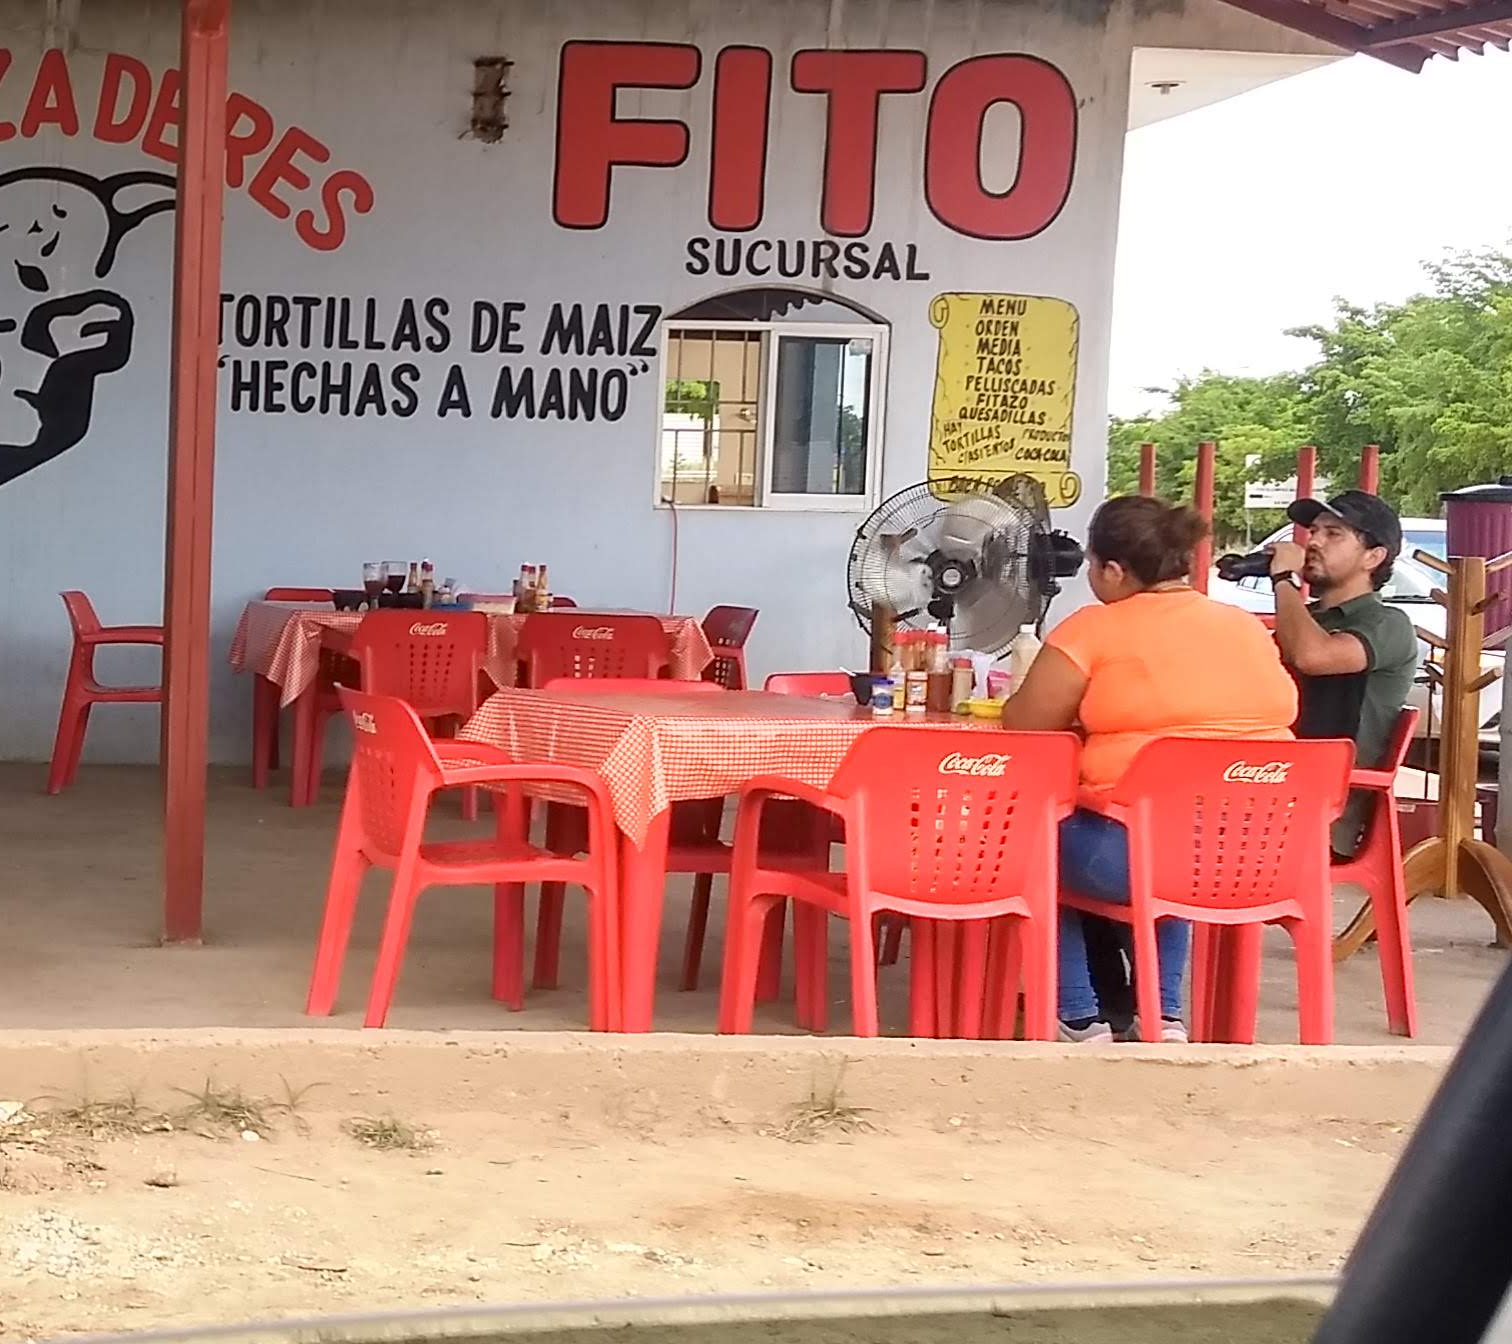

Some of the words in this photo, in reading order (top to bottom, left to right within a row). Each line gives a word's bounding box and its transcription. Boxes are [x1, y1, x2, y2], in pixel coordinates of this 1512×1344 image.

[552, 39, 1078, 241] FITO
[93, 53, 180, 164] DE
[224, 91, 375, 252] RES
[684, 236, 930, 281] SUCURSAL
[979, 299, 1028, 316] MENU
[218, 292, 450, 353] TORTILLAS
[470, 300, 526, 354] DE
[539, 302, 663, 358] MAIZ
[975, 319, 1020, 337] ORDEN
[976, 337, 1021, 357] MEDIA
[976, 356, 1023, 376] TACOS
[436, 364, 472, 418] A
[965, 375, 1056, 396] PELLISCADAS
[976, 393, 1028, 410] FITAZO
[958, 406, 1047, 426] QUESADILLAS
[942, 424, 1001, 454] TORTILLAS
[943, 421, 963, 437] HAY
